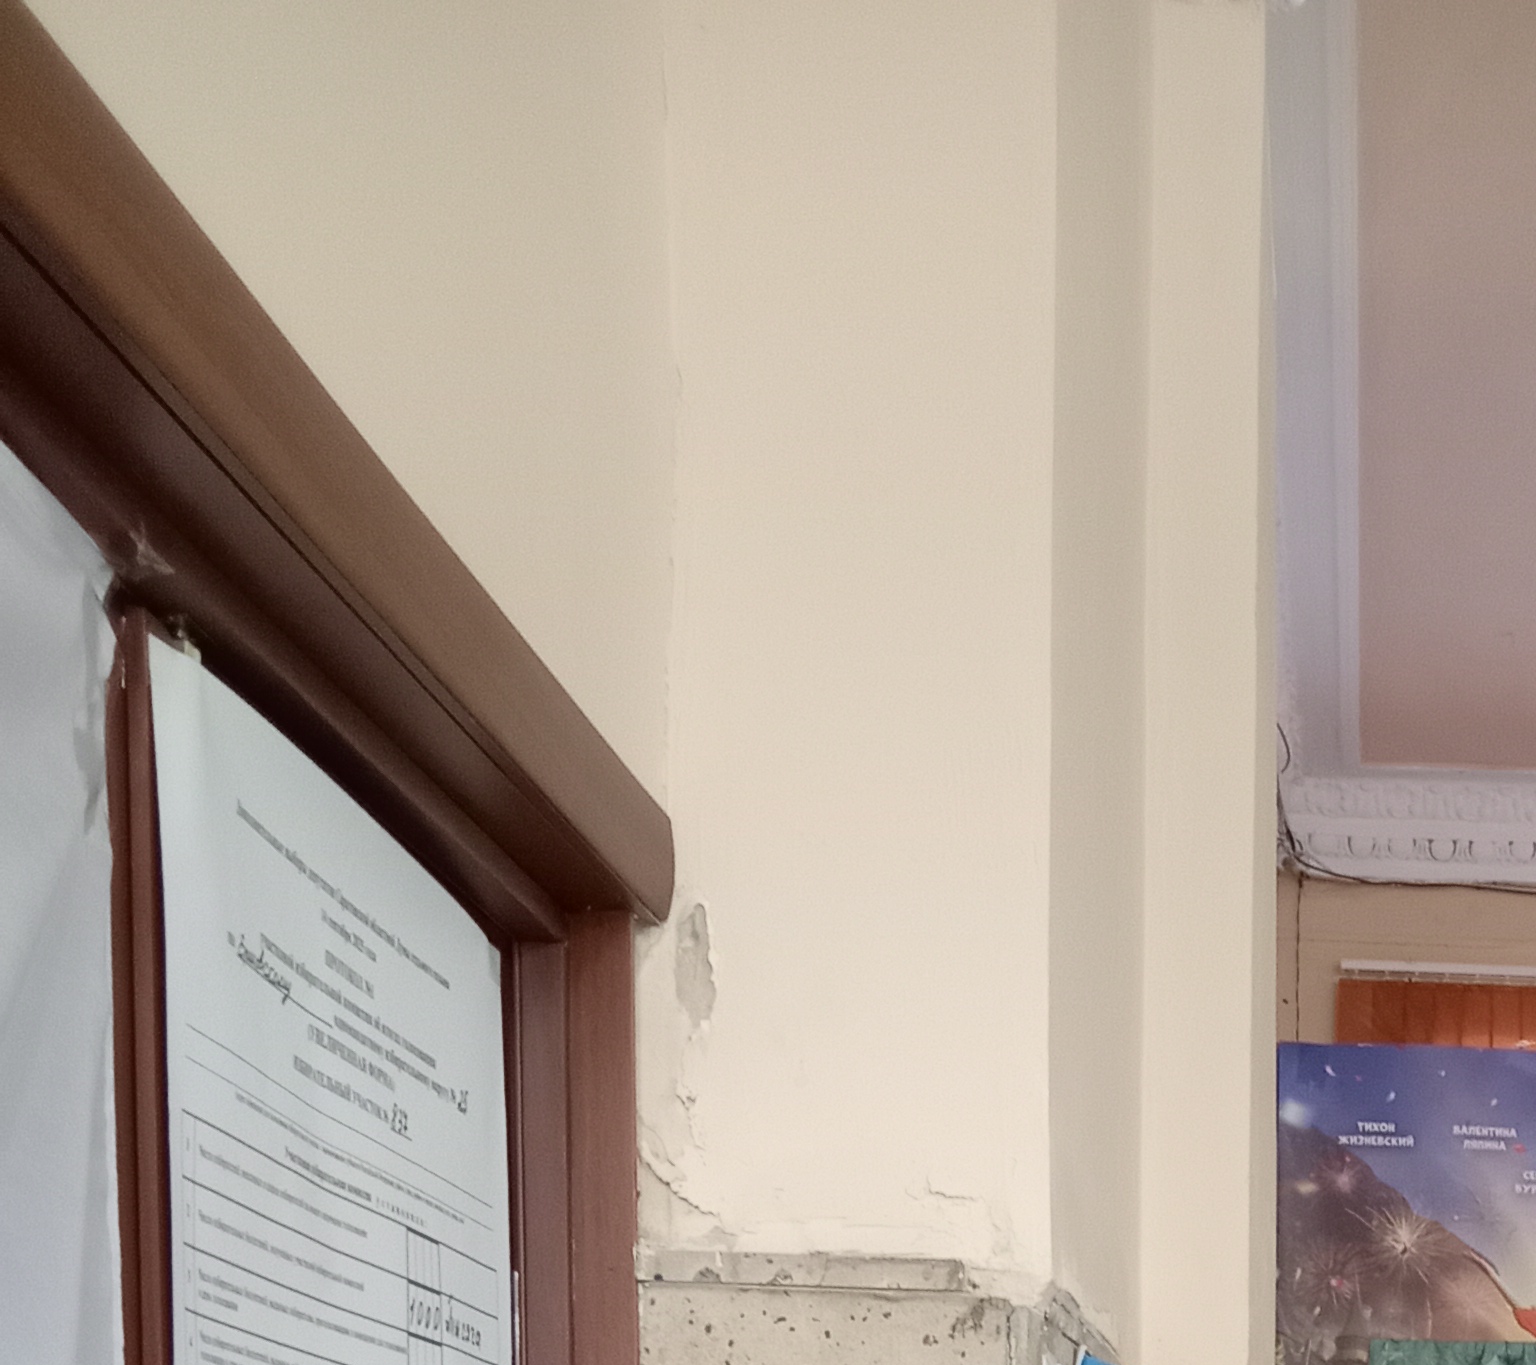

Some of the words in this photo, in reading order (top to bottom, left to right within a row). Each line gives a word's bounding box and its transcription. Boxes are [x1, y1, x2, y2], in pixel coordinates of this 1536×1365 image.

[1356, 1121, 1396, 1134] ТИХОН
[1453, 1124, 1518, 1139] ВАЛЕНТИНА
[1337, 1134, 1415, 1148] ЖИЗНЕВСКИЙ
